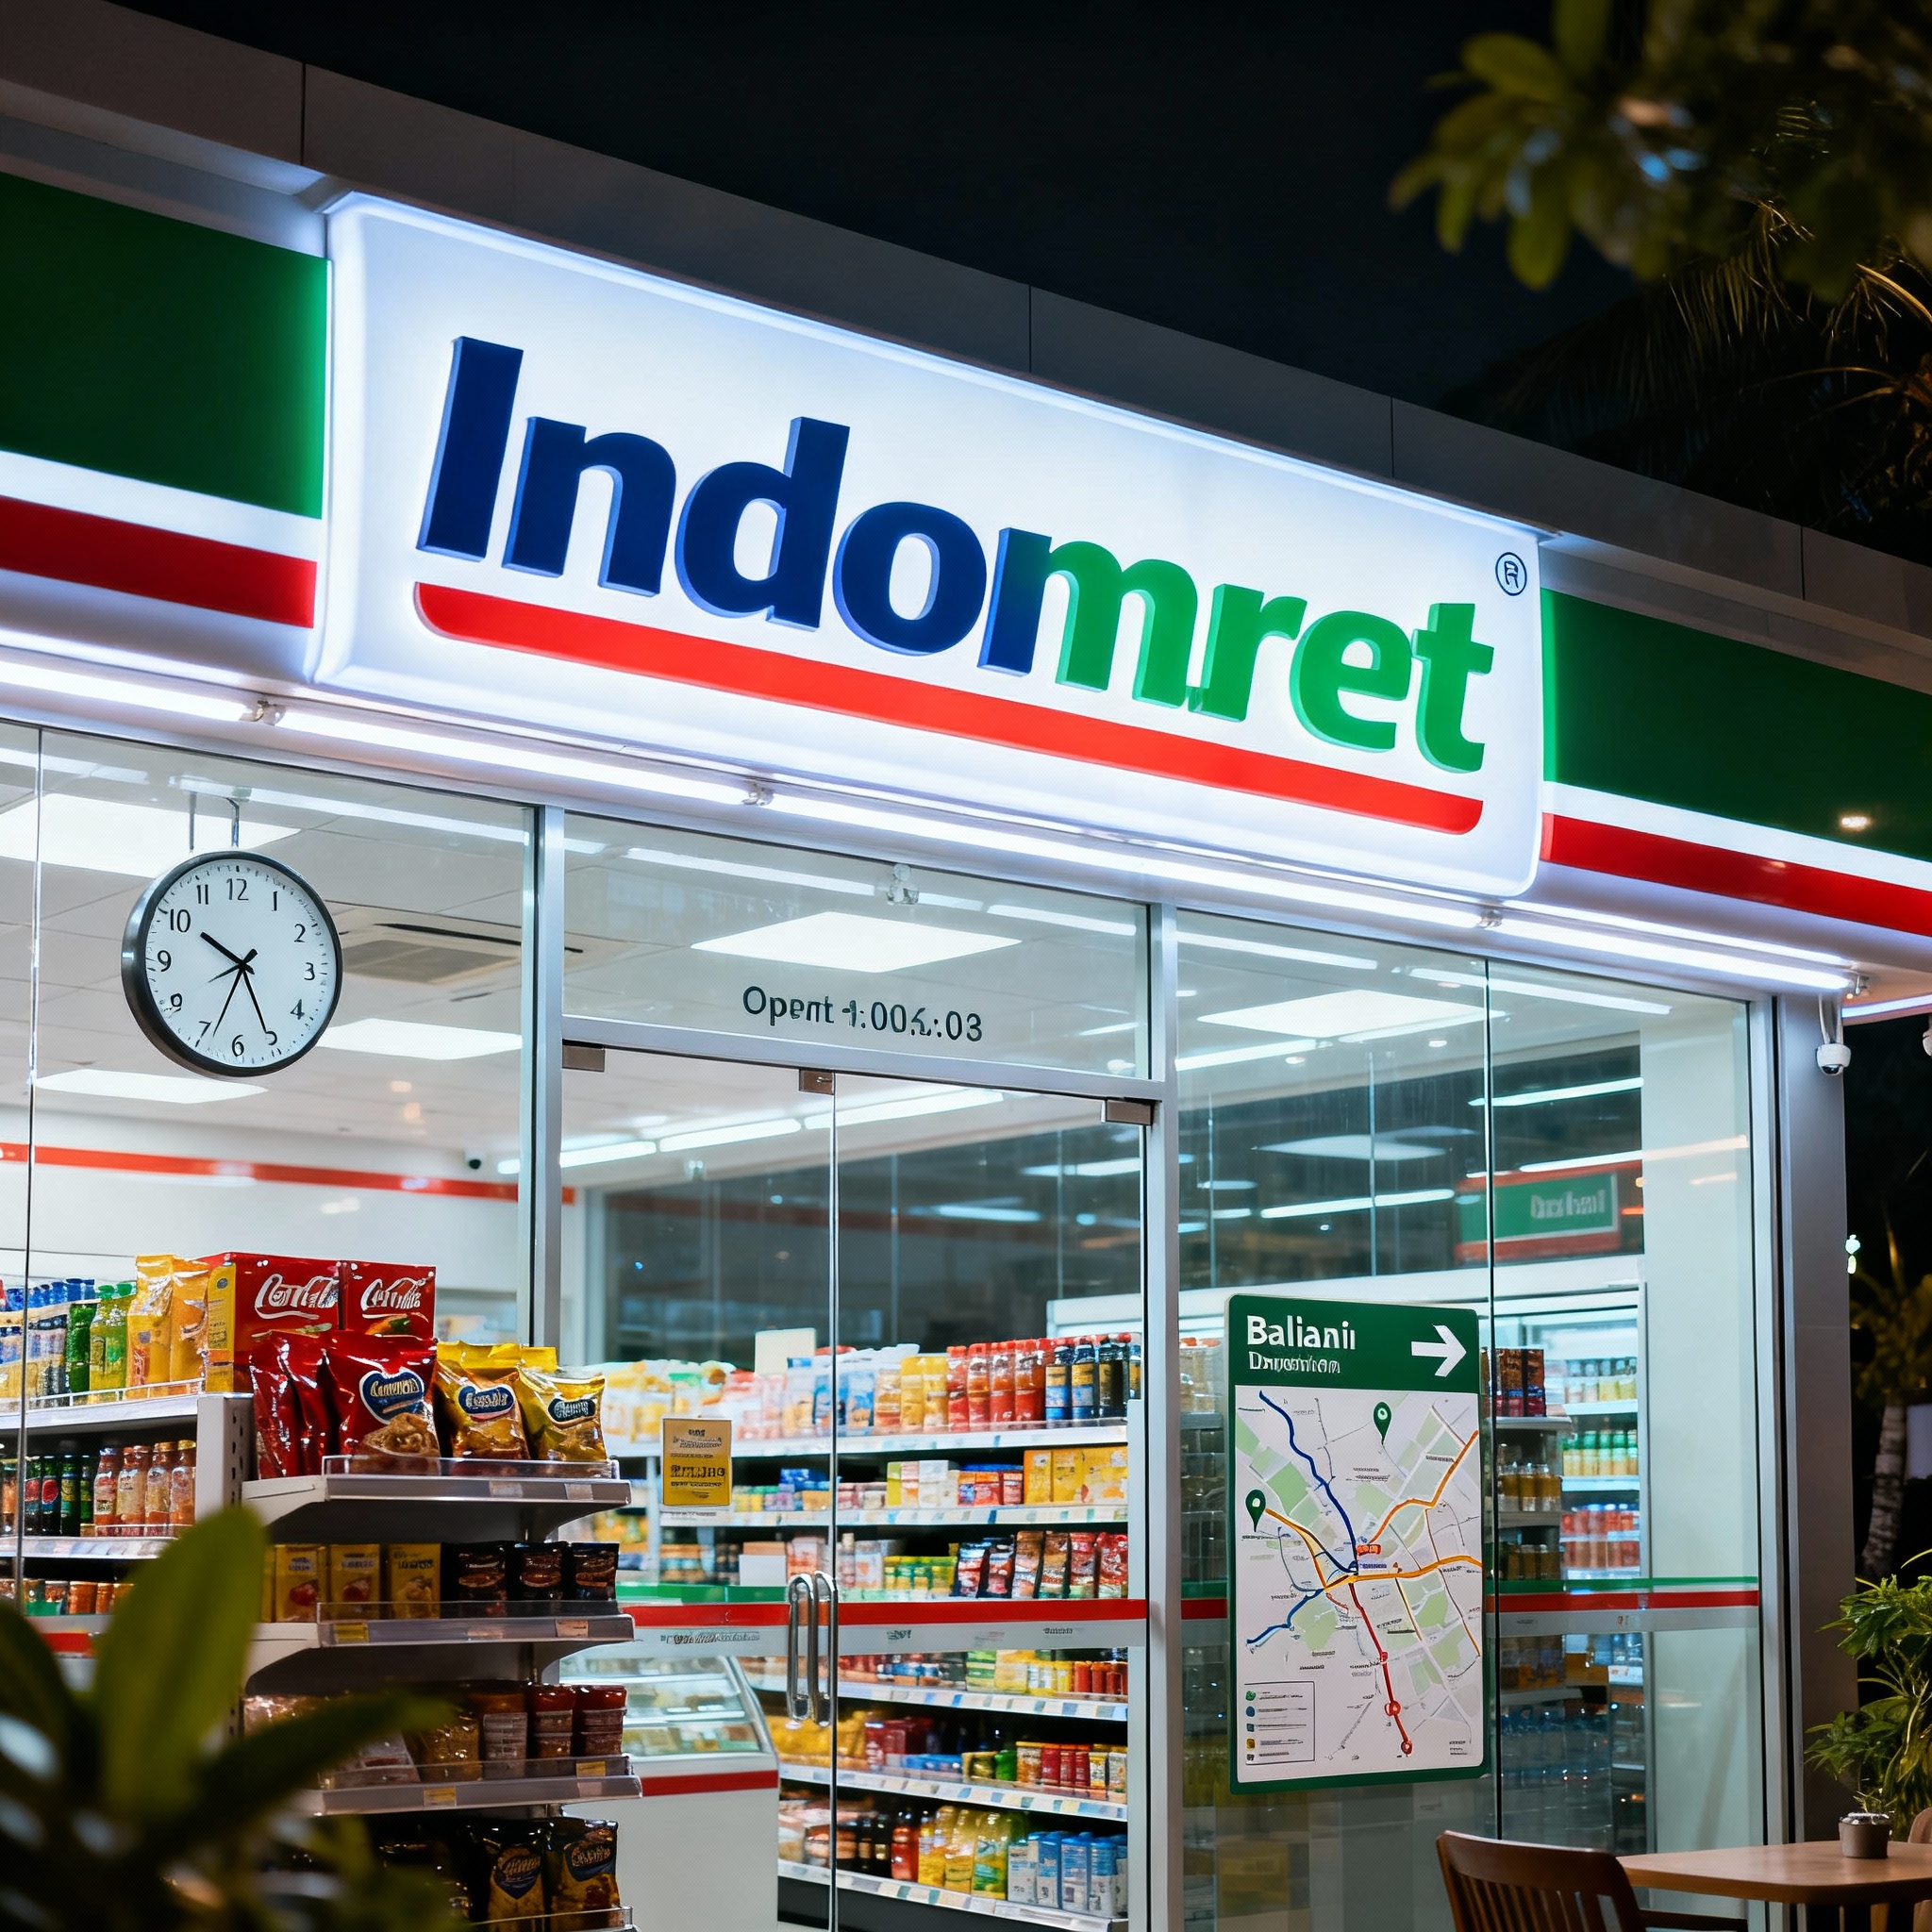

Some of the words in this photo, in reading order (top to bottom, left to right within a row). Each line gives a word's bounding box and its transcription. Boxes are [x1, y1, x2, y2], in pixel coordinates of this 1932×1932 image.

[416, 336, 1494, 773] Indomret
[196, 884, 209, 905] 11
[225, 877, 249, 901] 12
[272, 891, 278, 911] 1
[170, 908, 192, 933] 10
[293, 923, 306, 943] 2
[157, 950, 172, 973] 9
[303, 961, 316, 981] 3
[290, 998, 305, 1021] 4
[198, 1020, 211, 1039] 7
[231, 1034, 245, 1057] 6
